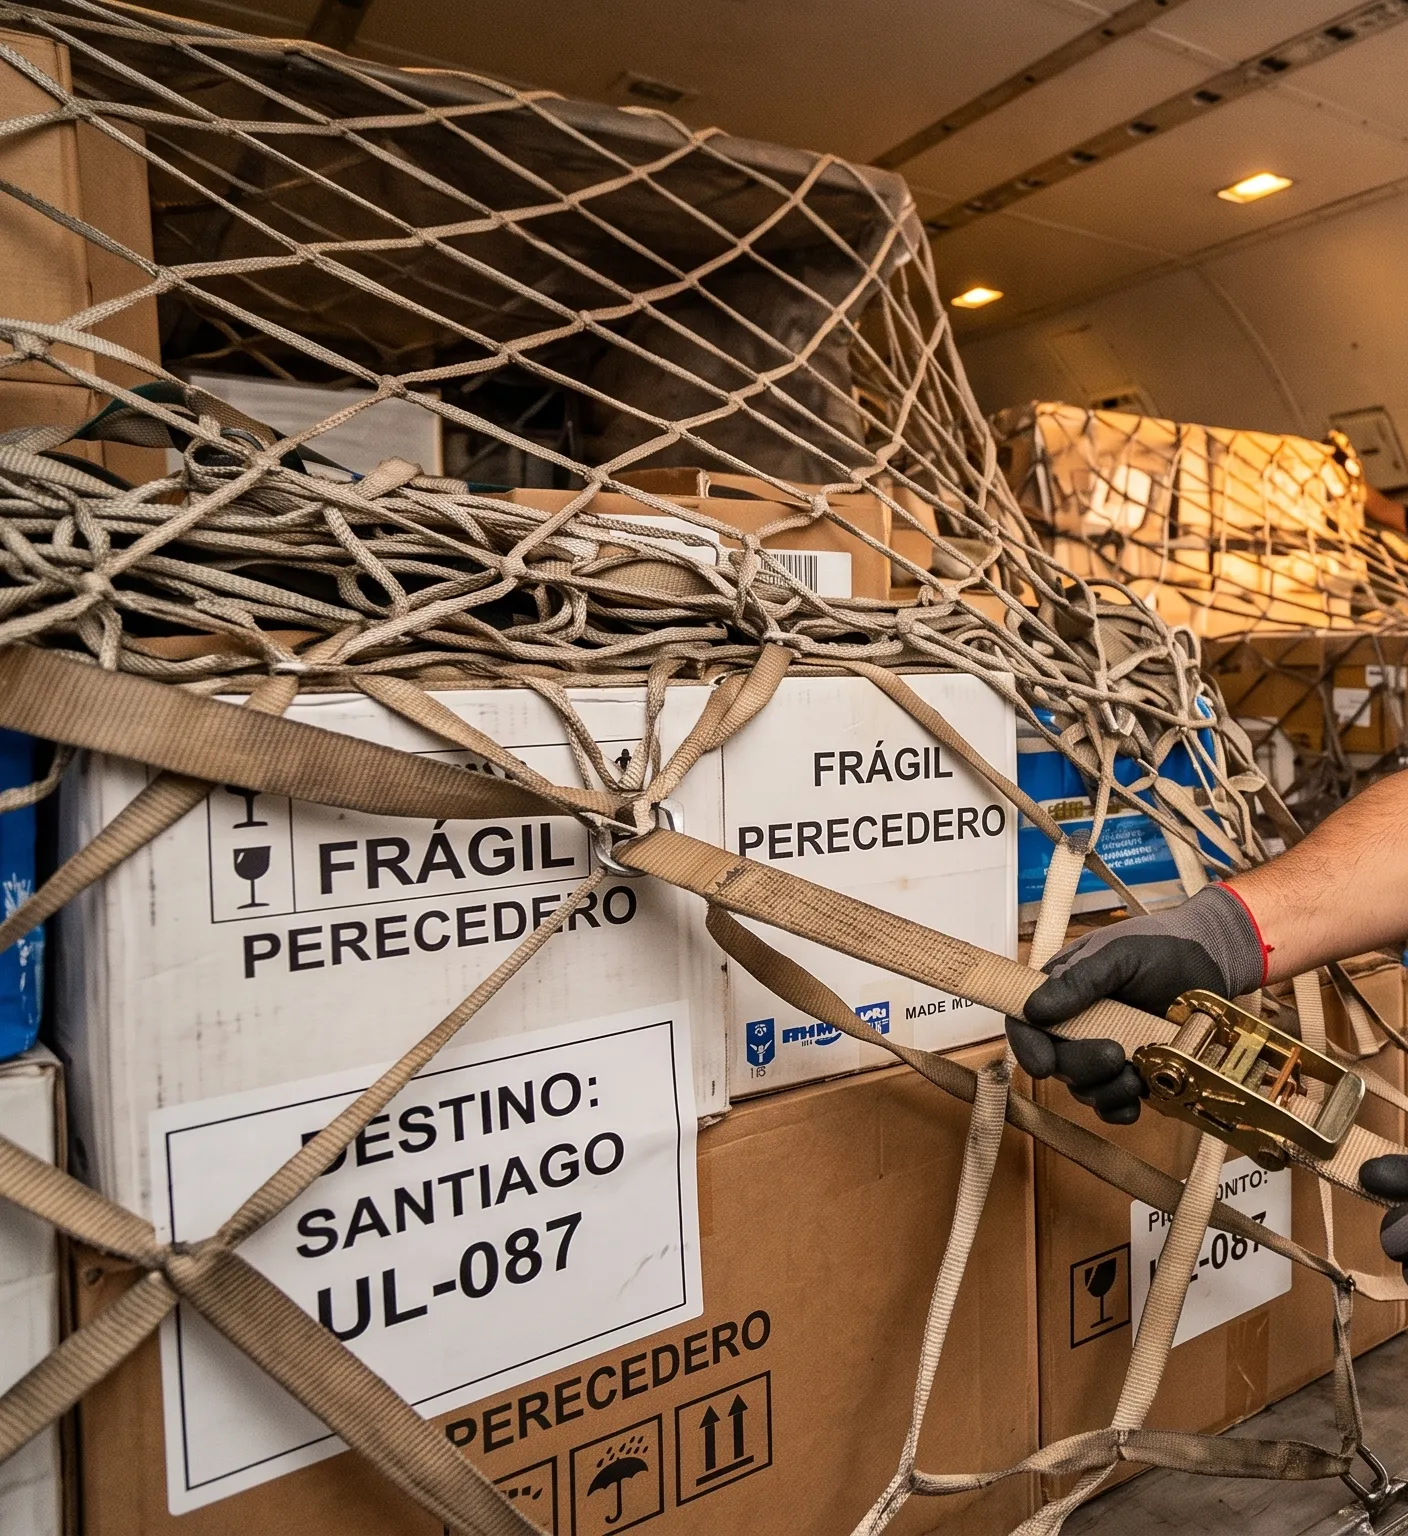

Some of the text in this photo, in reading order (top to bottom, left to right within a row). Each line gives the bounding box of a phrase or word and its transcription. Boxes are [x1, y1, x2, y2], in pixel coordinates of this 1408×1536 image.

[814, 739, 953, 787] FRÁGIL
[318, 819, 575, 896] FRÁGIL
[738, 803, 1006, 860] PERECEDERO
[243, 885, 638, 979] PERECEDERO
[905, 1000, 946, 1020] MADE
[295, 1130, 625, 1259] SANTIAGO
[317, 1211, 583, 1343] UL-087
[445, 1309, 772, 1455] PERECEDERO
